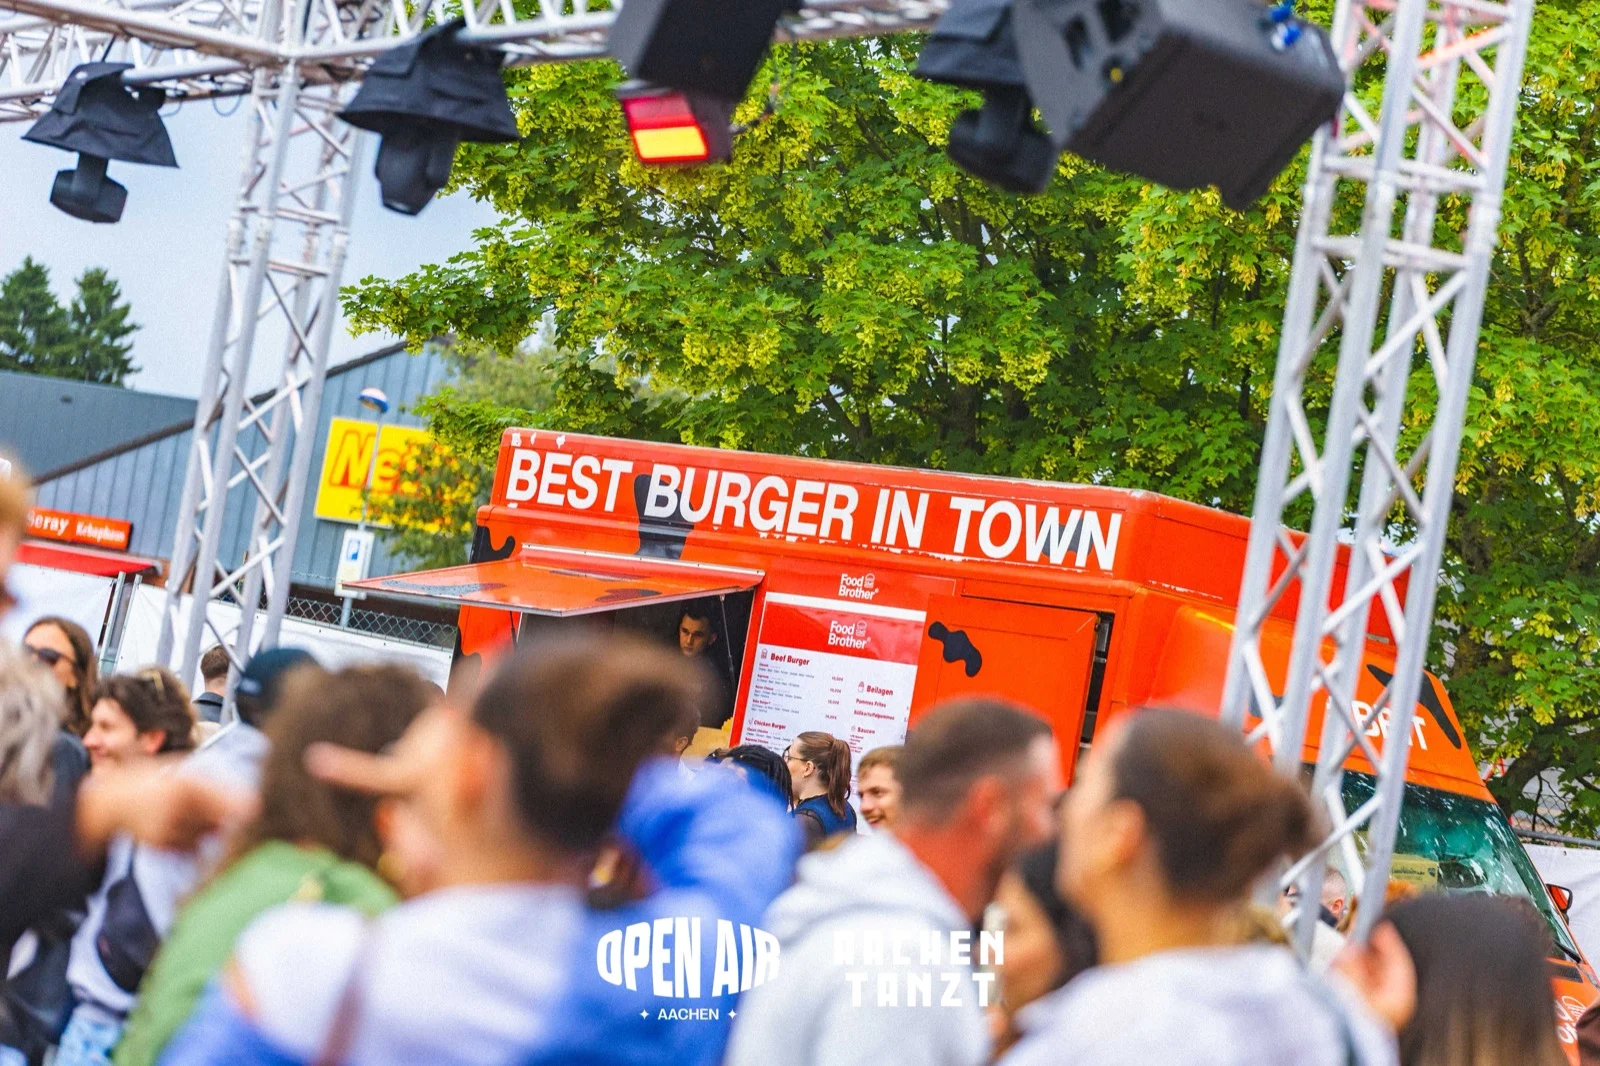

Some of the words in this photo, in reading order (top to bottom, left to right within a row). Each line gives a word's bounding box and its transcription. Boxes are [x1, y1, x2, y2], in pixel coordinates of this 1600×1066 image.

[506, 449, 635, 512] BEST
[643, 463, 859, 542] BURGER
[870, 487, 927, 548] IN
[949, 496, 1123, 572] TOWN
[840, 573, 864, 587] Food
[838, 585, 876, 600] Brother
[829, 620, 855, 635] Food
[827, 634, 867, 649] Brother
[770, 652, 787, 662] Beef
[787, 655, 810, 666] Burger
[866, 685, 894, 696] Beilagen
